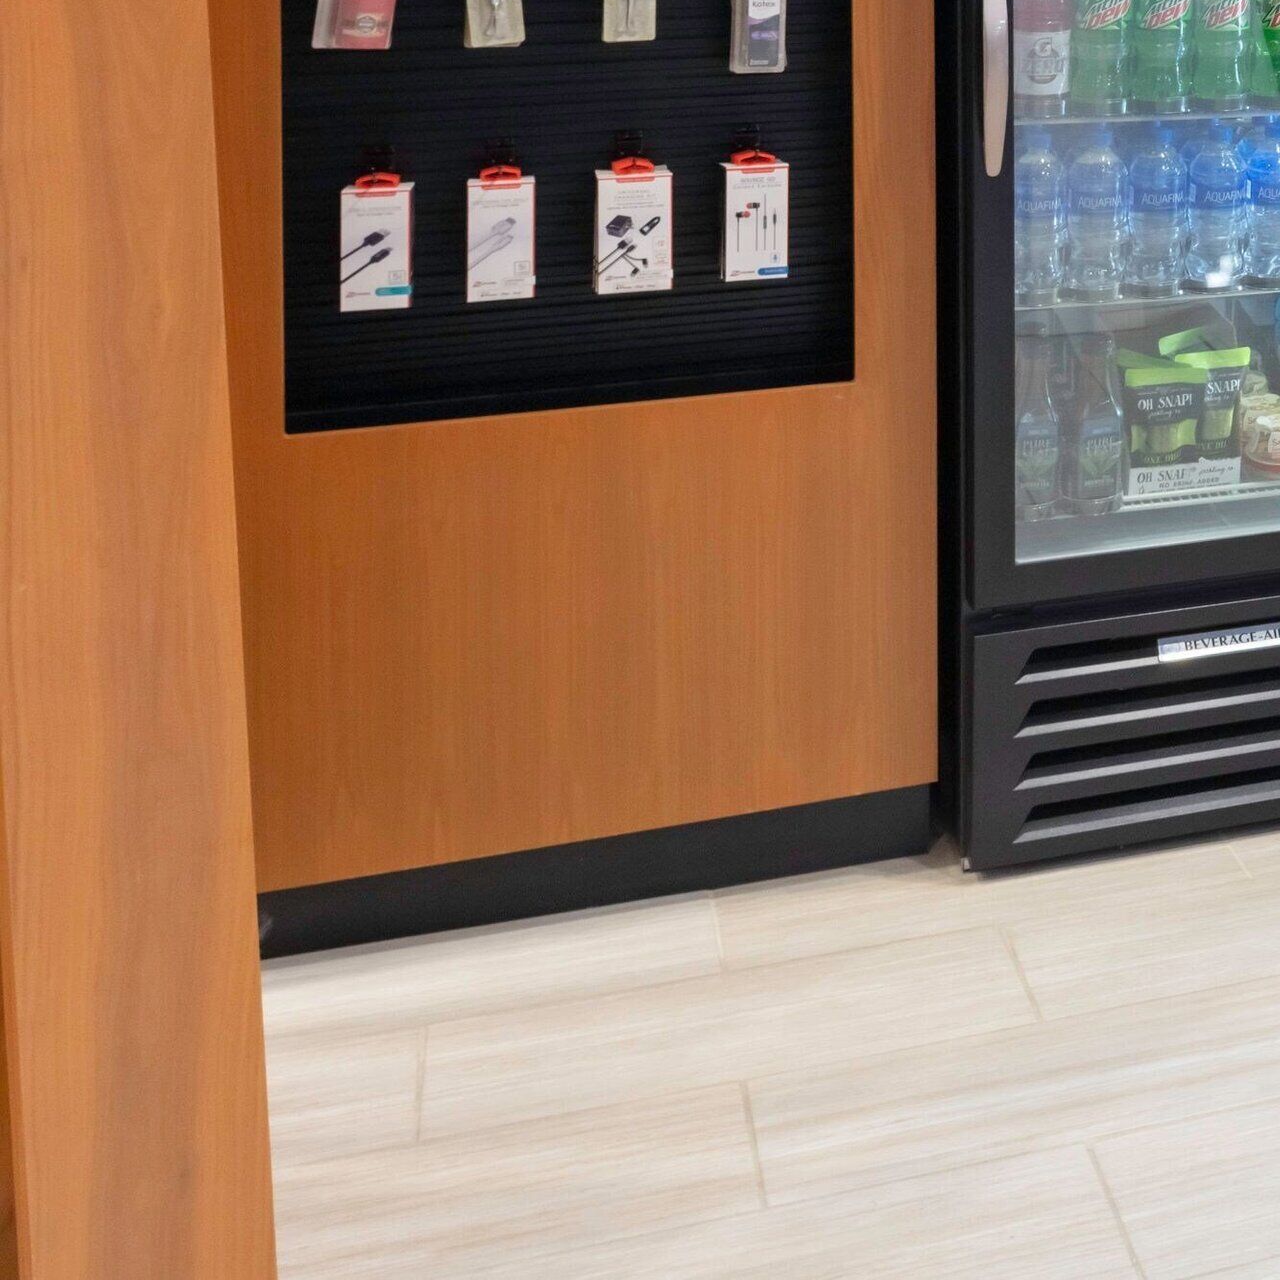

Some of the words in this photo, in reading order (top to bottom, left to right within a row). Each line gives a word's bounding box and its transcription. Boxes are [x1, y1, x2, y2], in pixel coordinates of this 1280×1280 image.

[1078, 196, 1122, 208] AQUAFINA
[1142, 192, 1185, 205] AQUAFINA
[1138, 399, 1153, 410] OH
[1158, 394, 1192, 409] SNAP!
